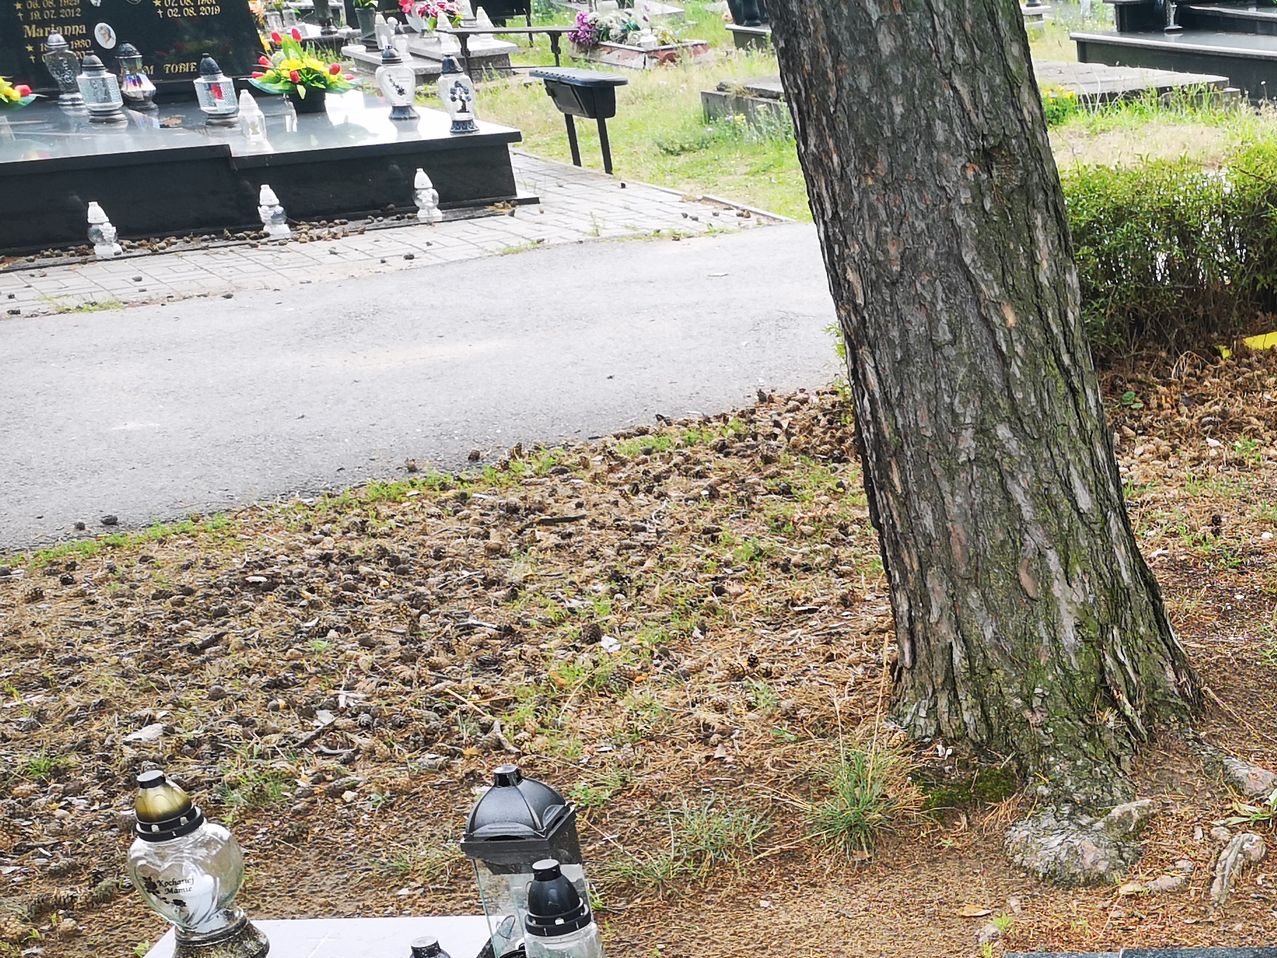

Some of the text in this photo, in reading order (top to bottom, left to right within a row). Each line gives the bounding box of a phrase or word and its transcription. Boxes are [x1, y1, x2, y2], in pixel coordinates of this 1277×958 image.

[60, 8, 81, 18] 2012
[24, 24, 86, 38] Marianna
[163, 62, 197, 74] TOBIE
